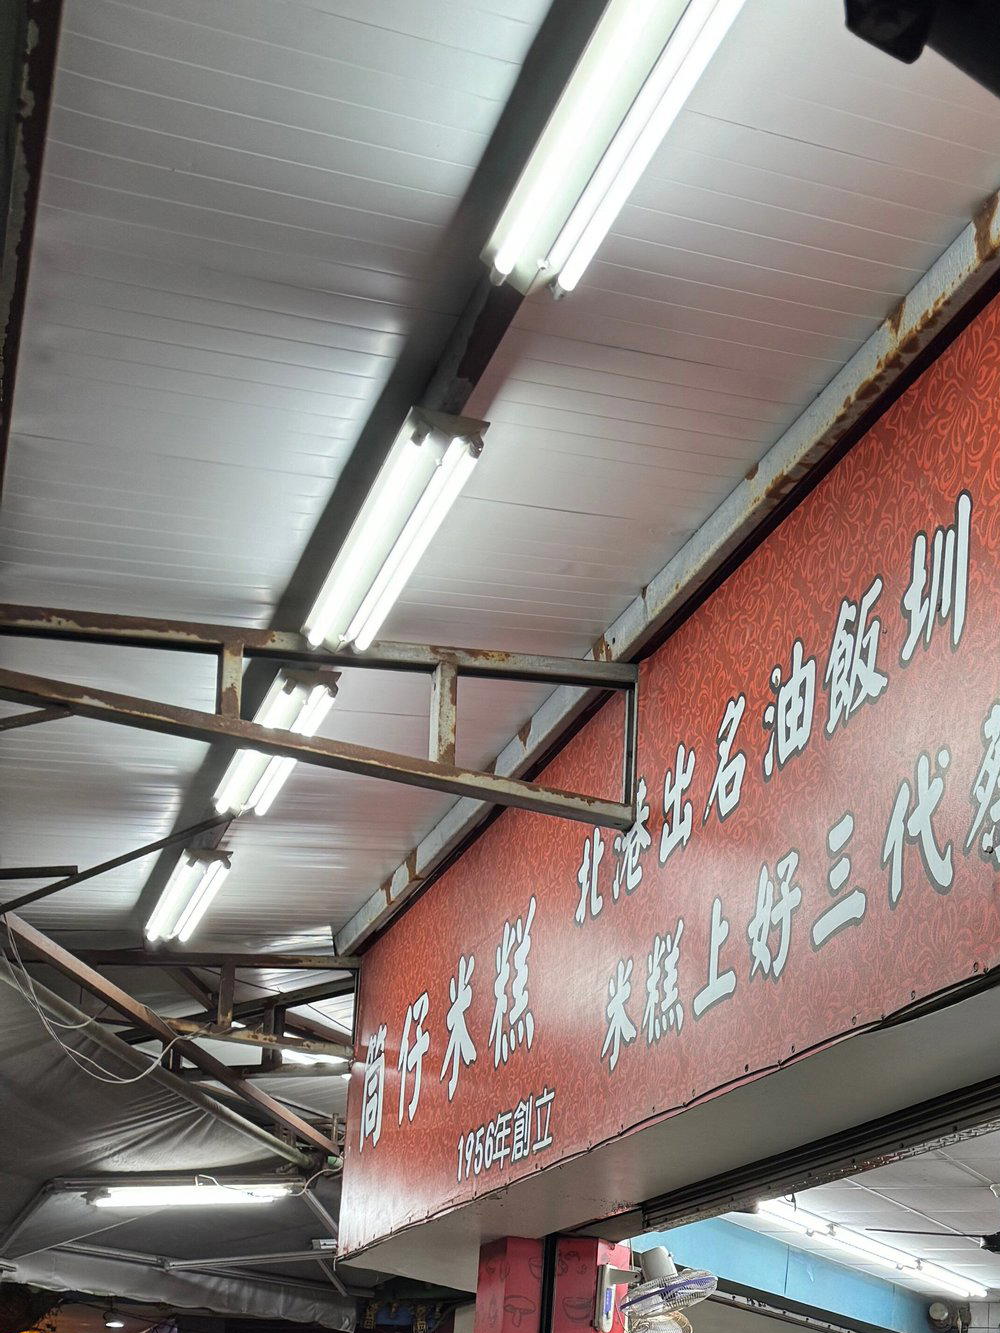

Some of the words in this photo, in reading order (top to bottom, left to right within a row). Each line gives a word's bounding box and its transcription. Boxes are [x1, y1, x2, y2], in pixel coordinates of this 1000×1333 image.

[359, 896, 536, 1153] 筒仔米糕
[457, 1087, 556, 1183] 1956年創立
